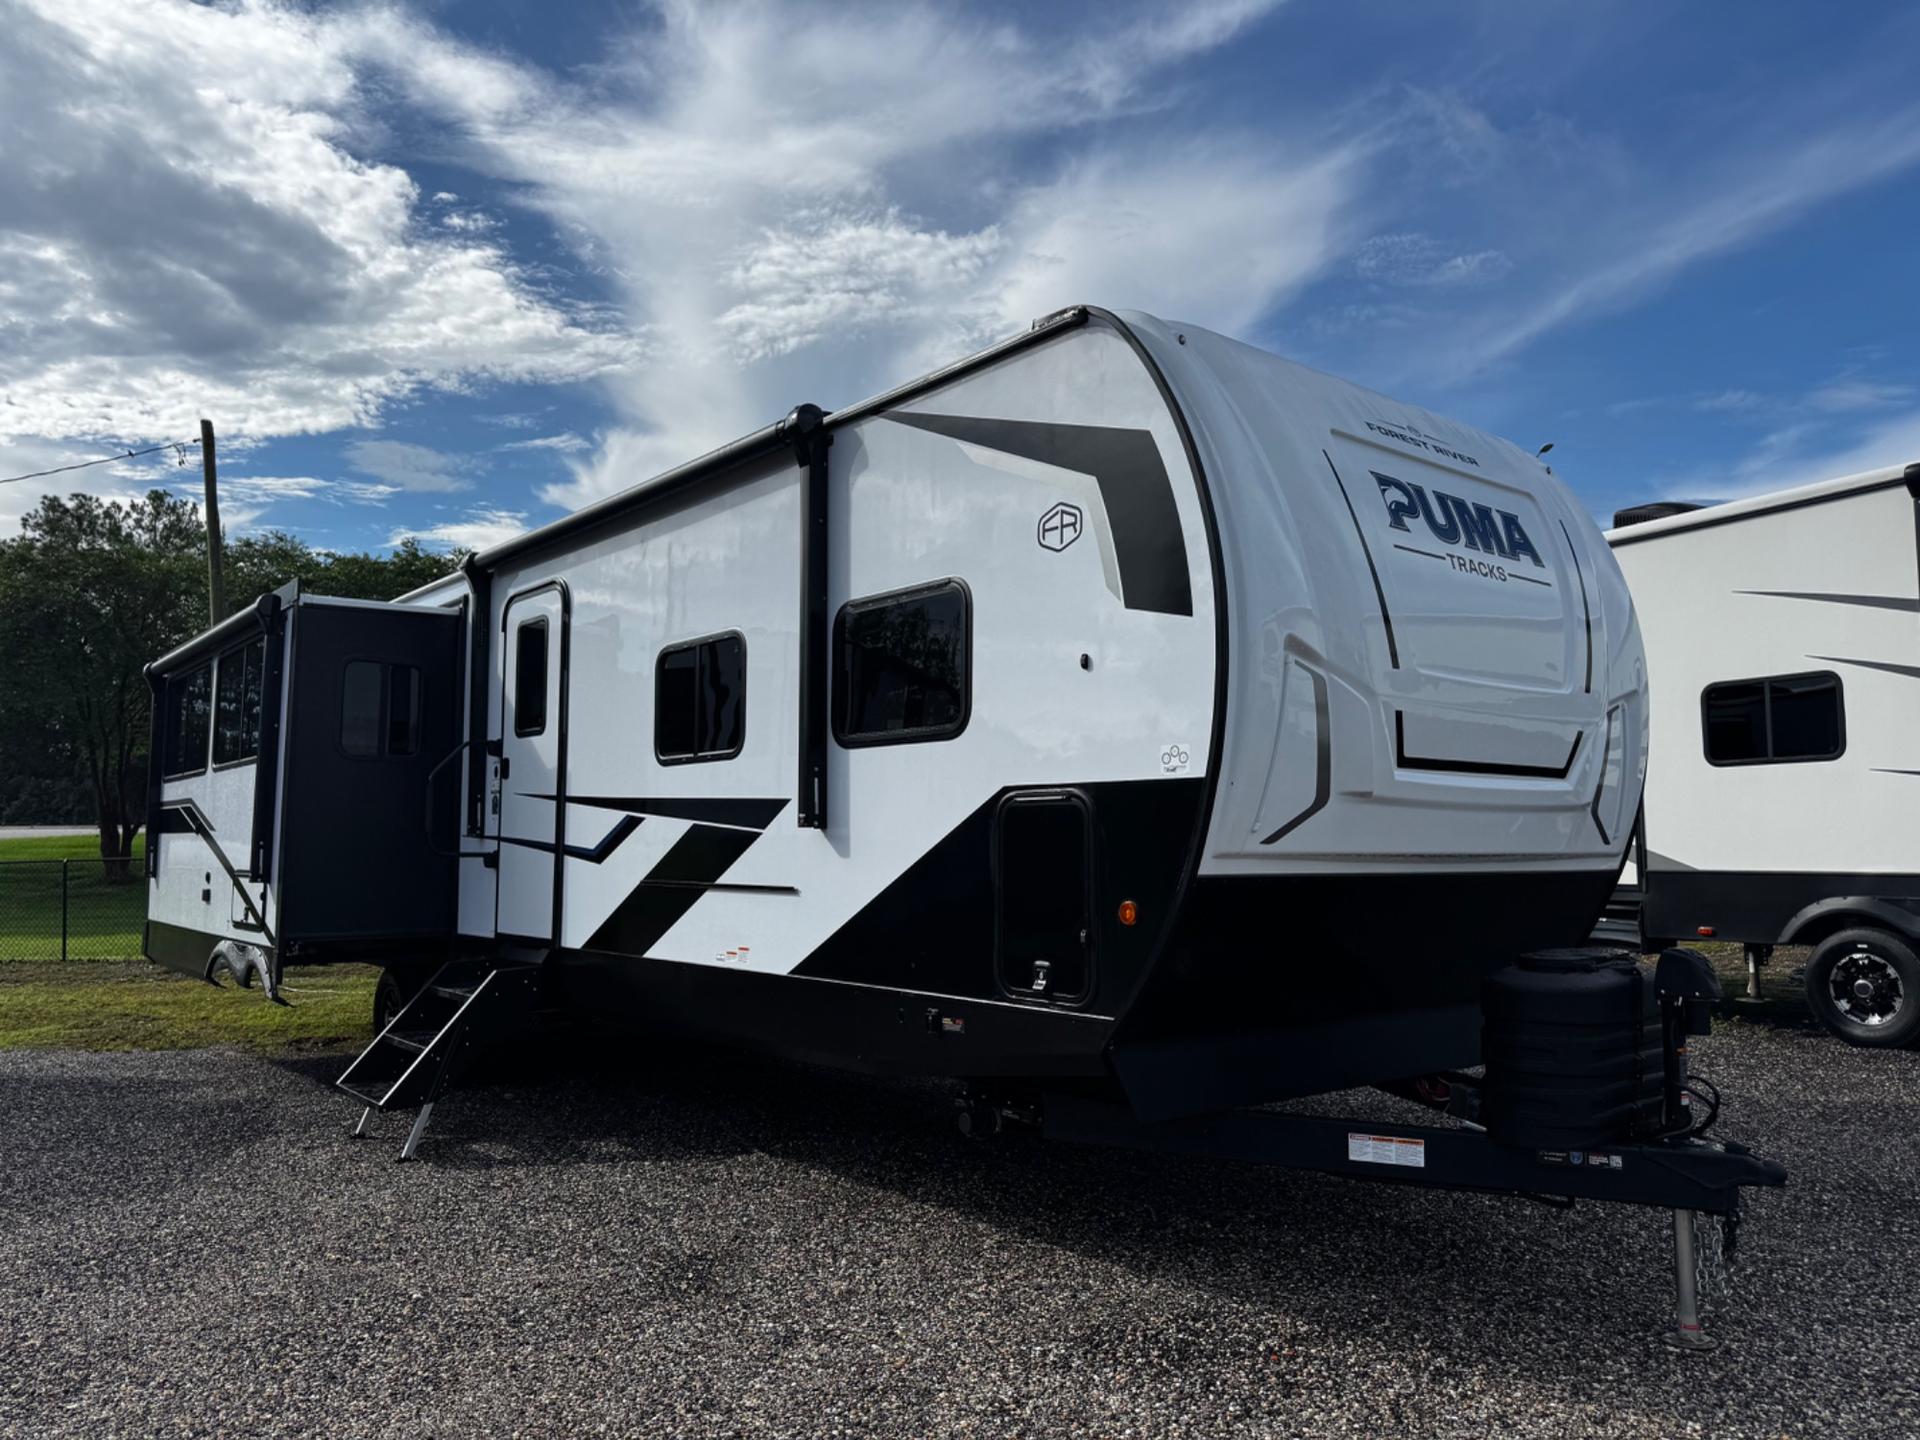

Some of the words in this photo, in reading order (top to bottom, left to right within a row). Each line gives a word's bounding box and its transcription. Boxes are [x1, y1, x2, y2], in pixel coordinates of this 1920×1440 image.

[1365, 421, 1429, 449] FOREST
[1433, 445, 1480, 467] RIVER
[1043, 509, 1077, 544] FR
[1368, 470, 1545, 568] PUMA
[1446, 553, 1508, 582] TRACKS
